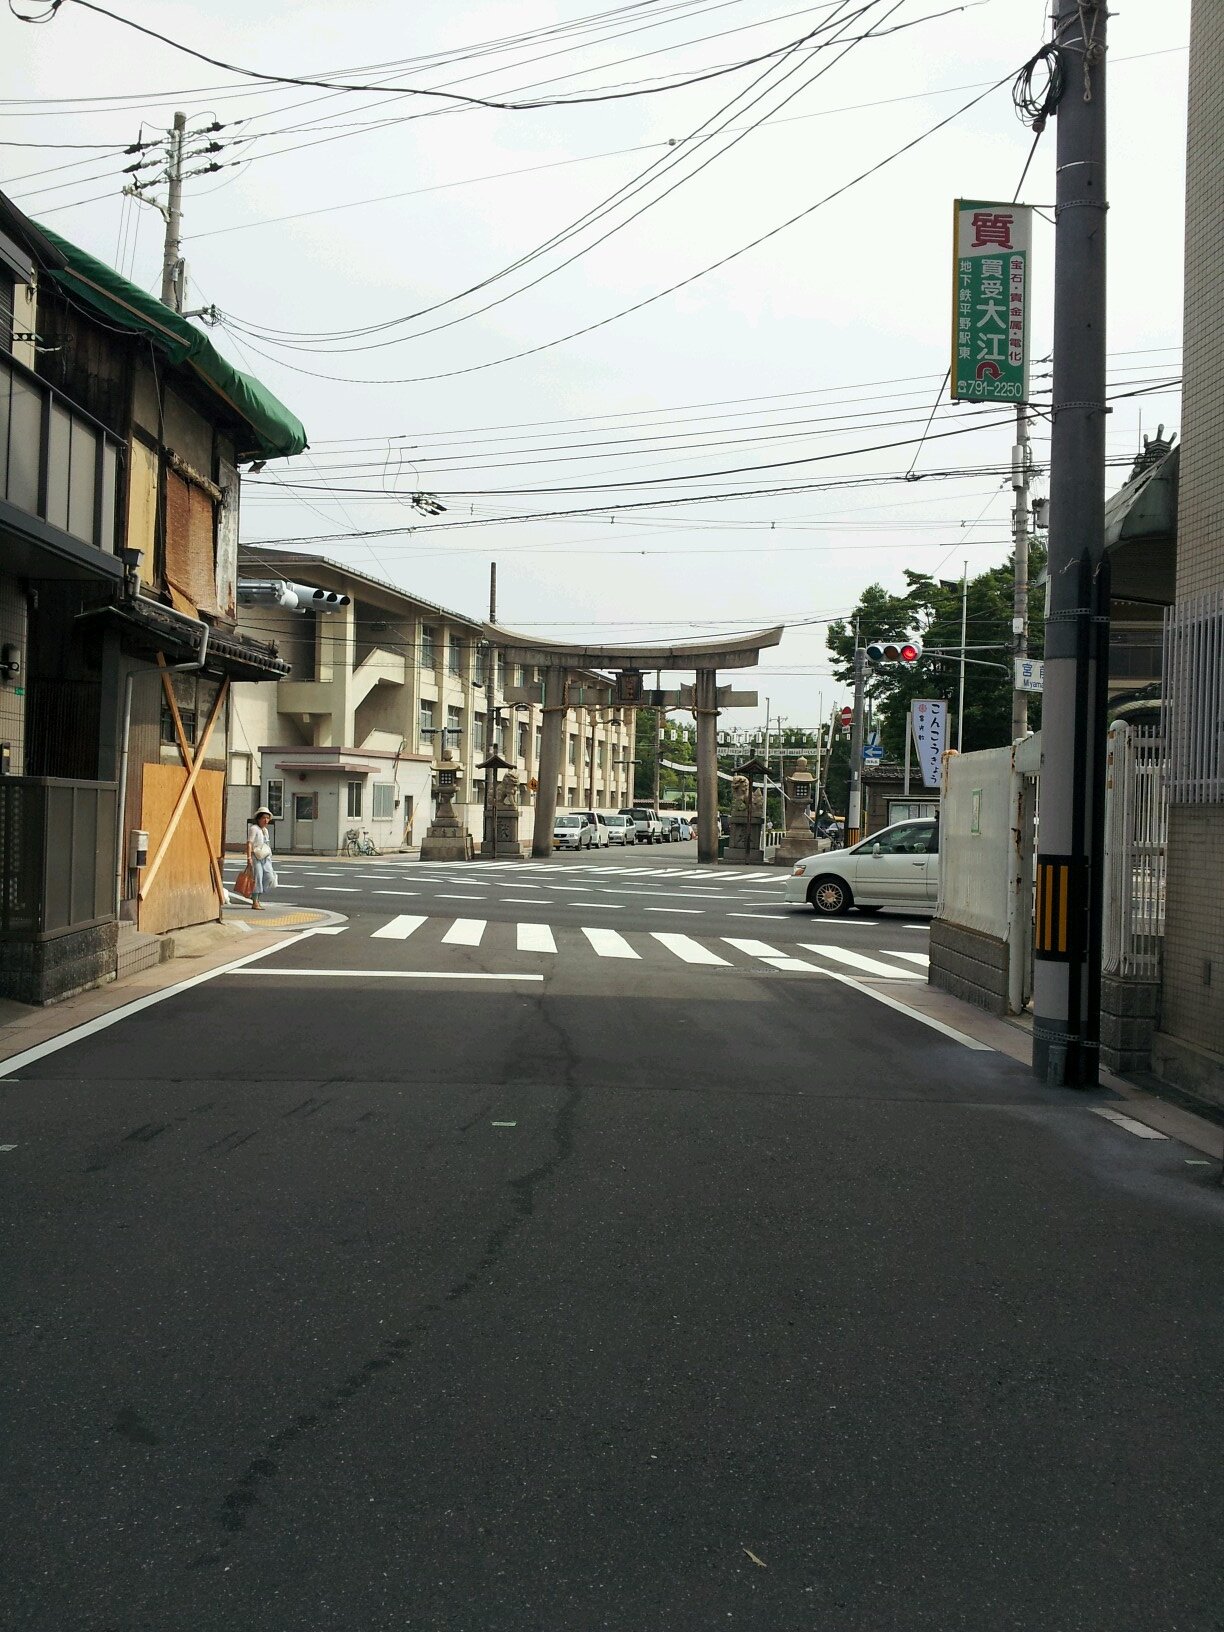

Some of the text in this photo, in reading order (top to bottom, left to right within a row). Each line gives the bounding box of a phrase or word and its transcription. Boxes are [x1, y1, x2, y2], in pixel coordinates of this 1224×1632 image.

[971, 212, 1014, 249] 質
[958, 260, 971, 360] 地下鉄平野駅東
[930, 703, 940, 783] こんこうきょう
